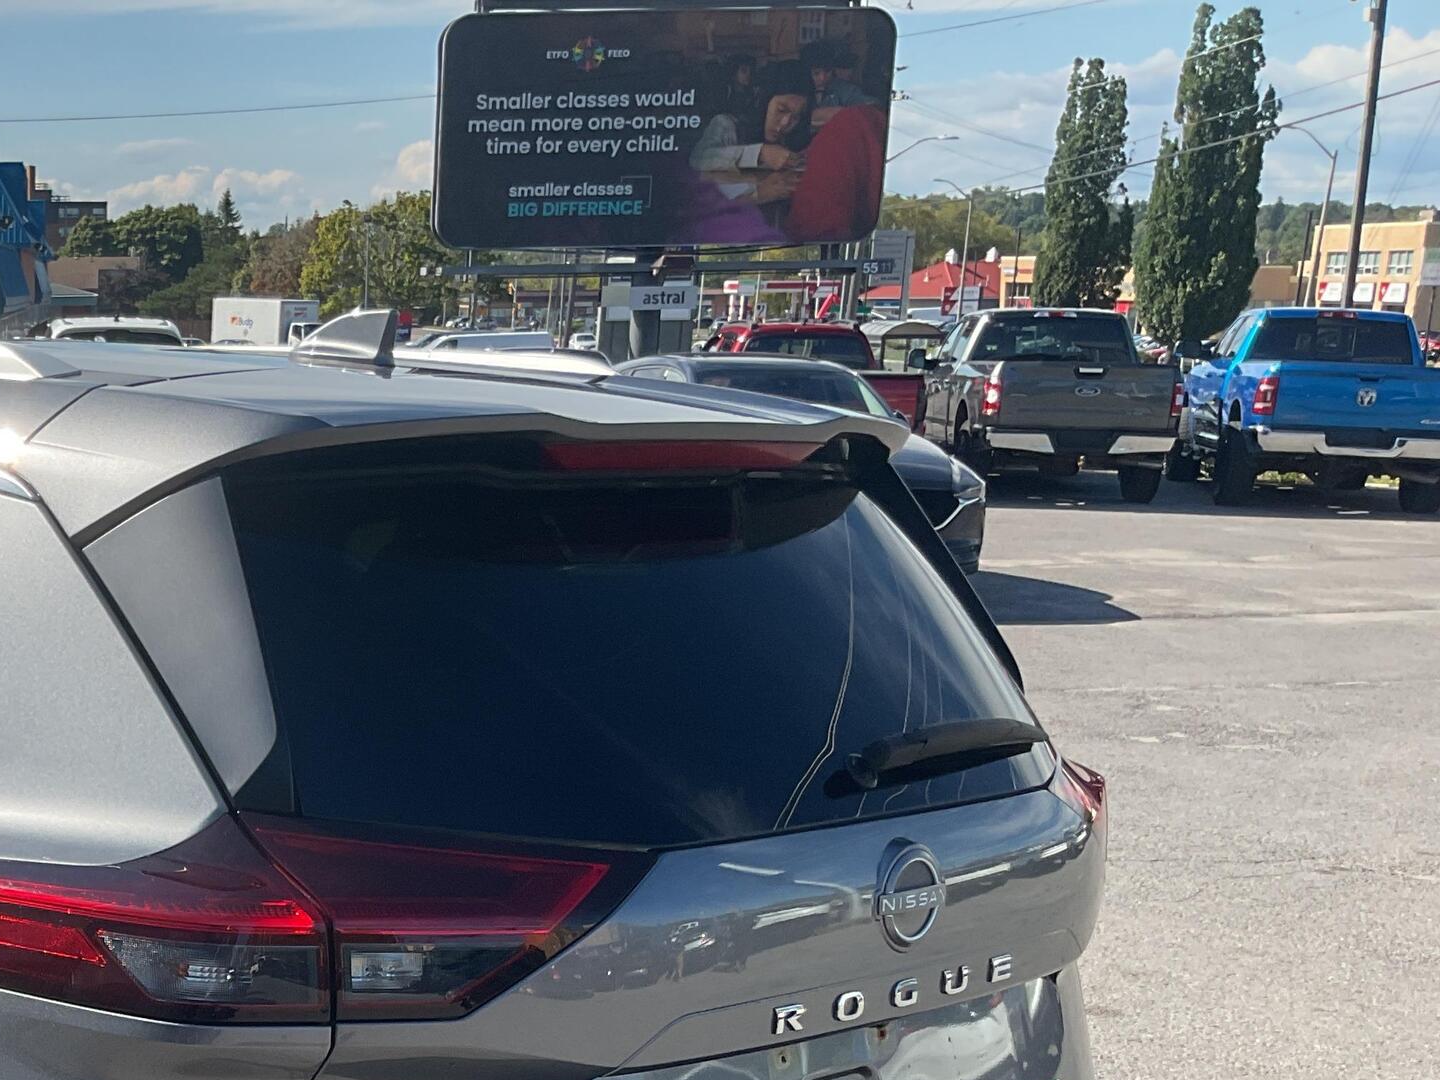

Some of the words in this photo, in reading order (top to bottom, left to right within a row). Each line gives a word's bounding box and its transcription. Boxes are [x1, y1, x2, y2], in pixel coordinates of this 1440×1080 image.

[476, 93, 551, 110] Smaller
[556, 92, 630, 109] classes
[635, 89, 695, 107] would
[468, 117, 525, 133] mean
[531, 116, 583, 132] more
[588, 114, 701, 131] one-on-one
[486, 137, 530, 154] time
[535, 136, 563, 154] for
[567, 138, 622, 157] every
[626, 135, 679, 152] child.
[509, 182, 571, 198] smaller
[573, 182, 633, 196] classes
[507, 202, 538, 217] BIG
[542, 200, 643, 217] DIFFERENCE
[642, 290, 686, 305] astral
[771, 954, 1014, 1034] ROGUE
